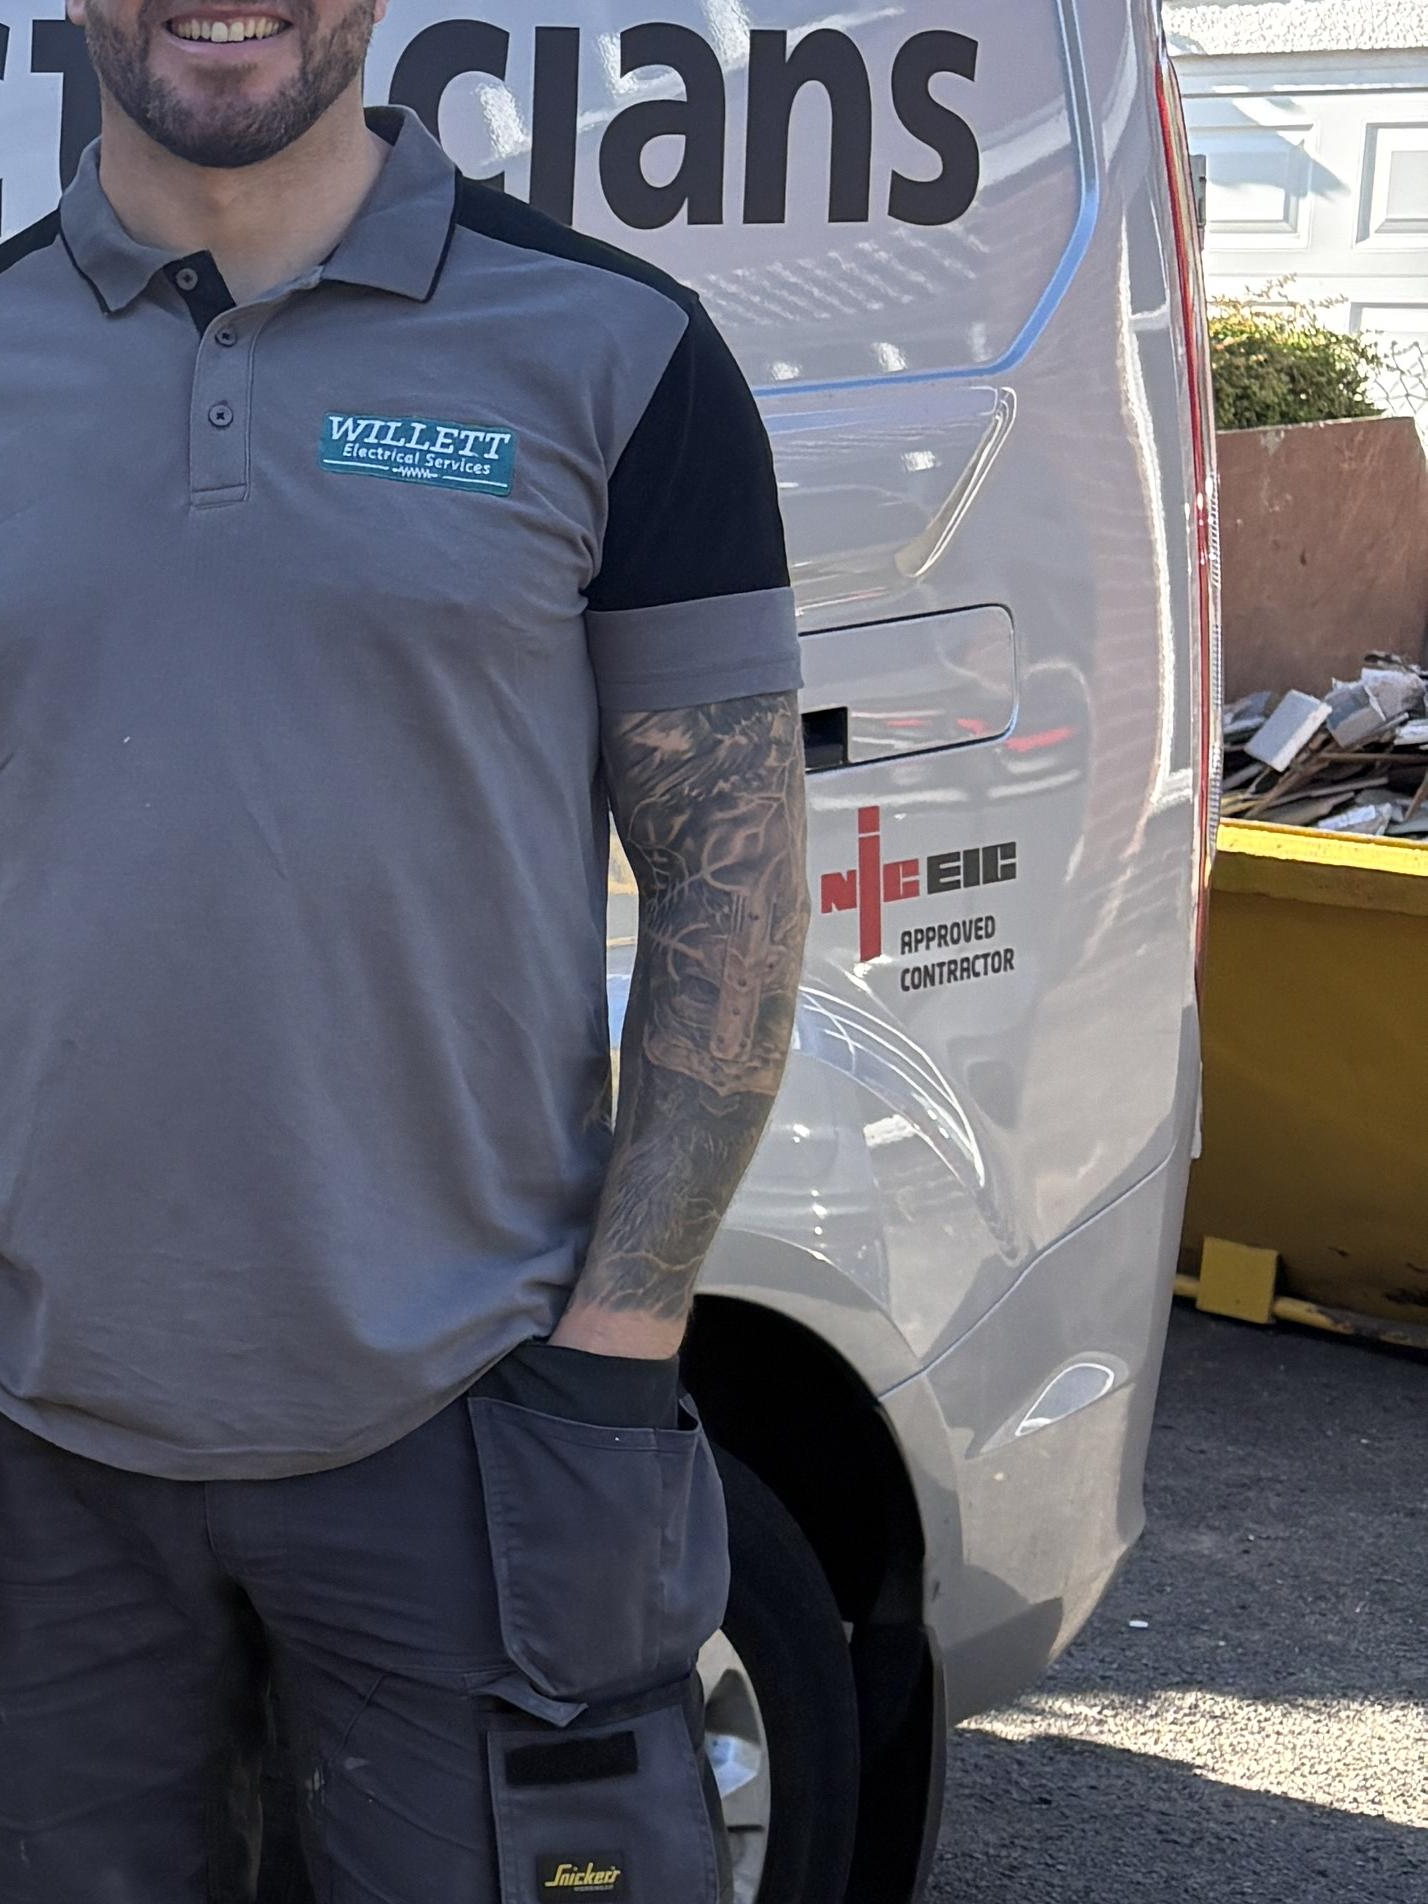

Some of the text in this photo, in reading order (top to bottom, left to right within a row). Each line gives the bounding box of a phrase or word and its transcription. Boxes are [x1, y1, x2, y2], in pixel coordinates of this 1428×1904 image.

[328, 415, 512, 459] WILLETT
[343, 442, 492, 476] Electrical Services
[899, 915, 996, 957] APPROVED
[899, 948, 1015, 993] CONTRACTOR
[544, 1861, 621, 1887] Snickers
